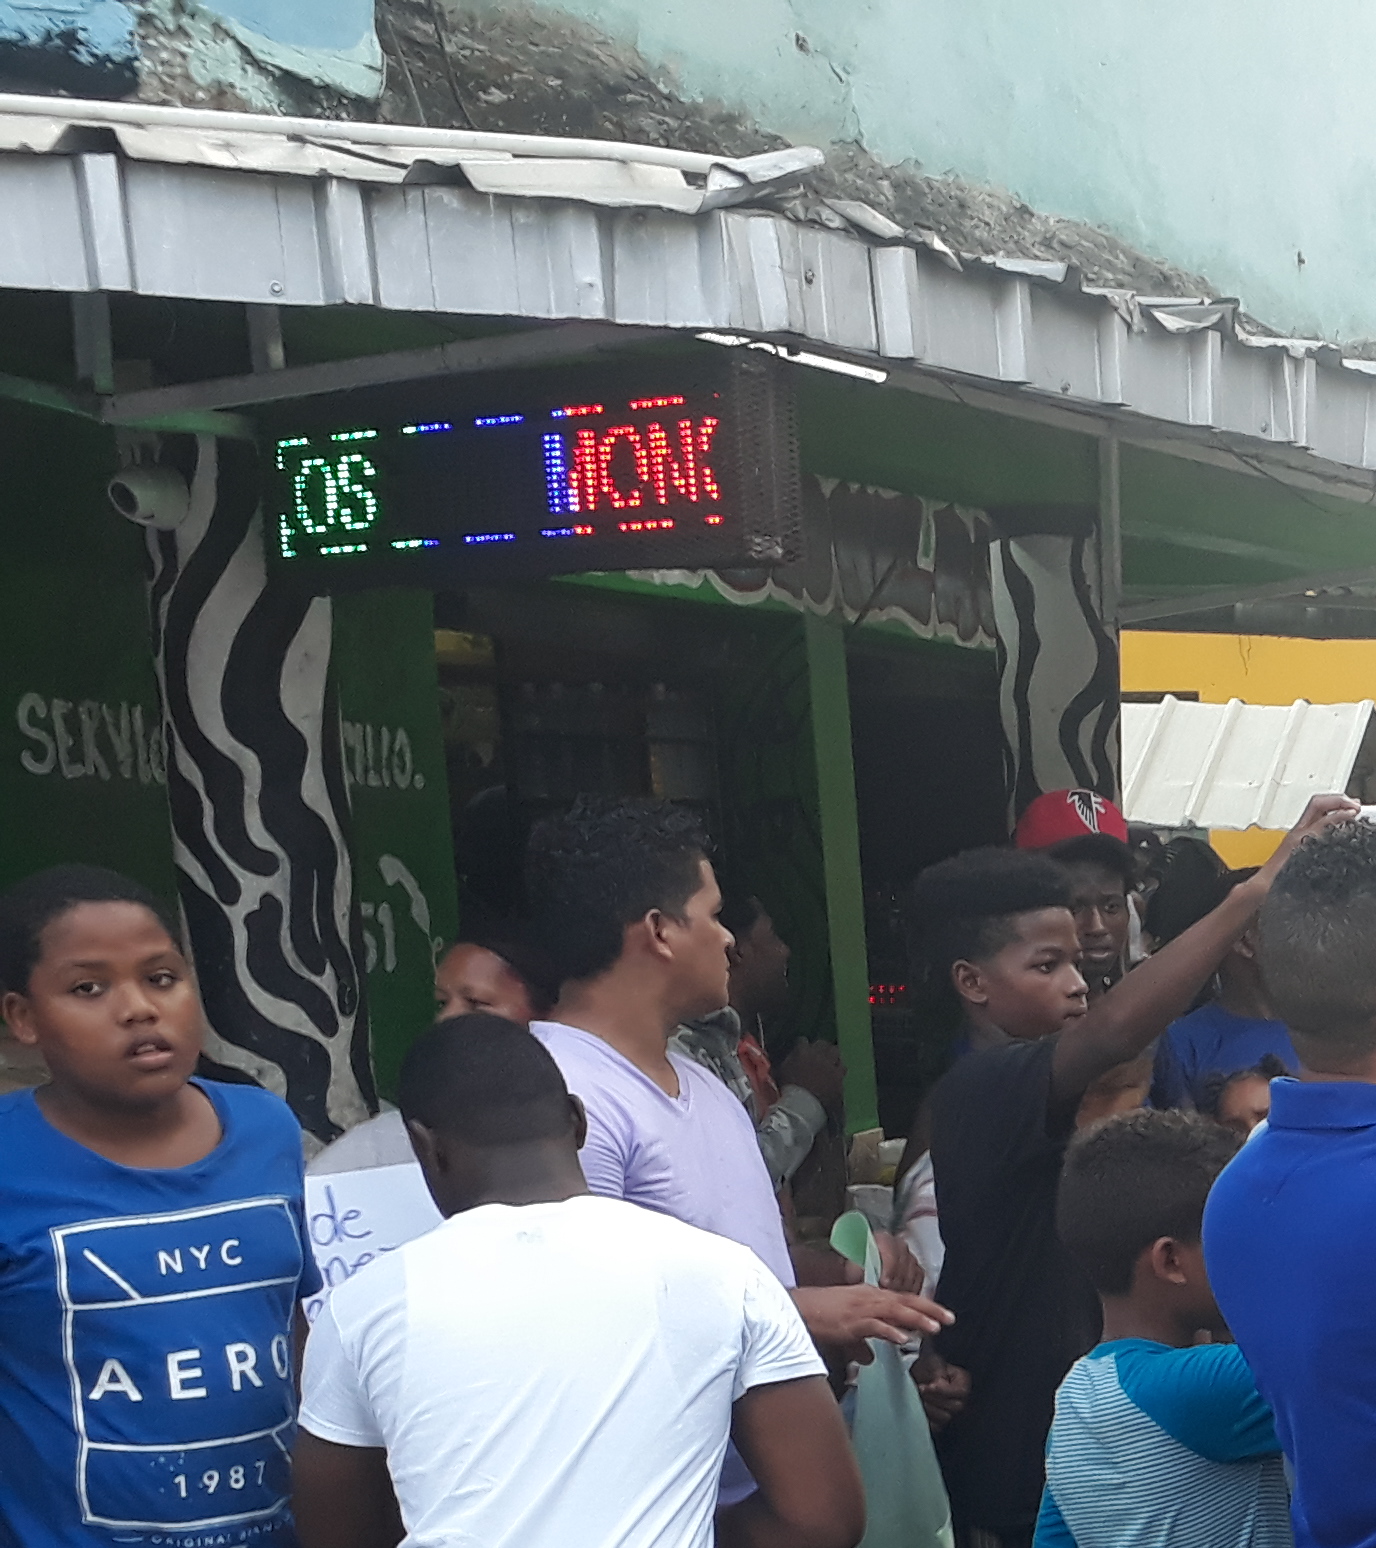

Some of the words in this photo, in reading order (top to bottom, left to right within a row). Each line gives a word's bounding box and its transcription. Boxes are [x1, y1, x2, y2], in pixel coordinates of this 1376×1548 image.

[311, 1185, 373, 1246] de
[158, 1239, 243, 1275] NYC
[87, 1333, 289, 1402] AERO
[173, 1460, 266, 1498] 1987
